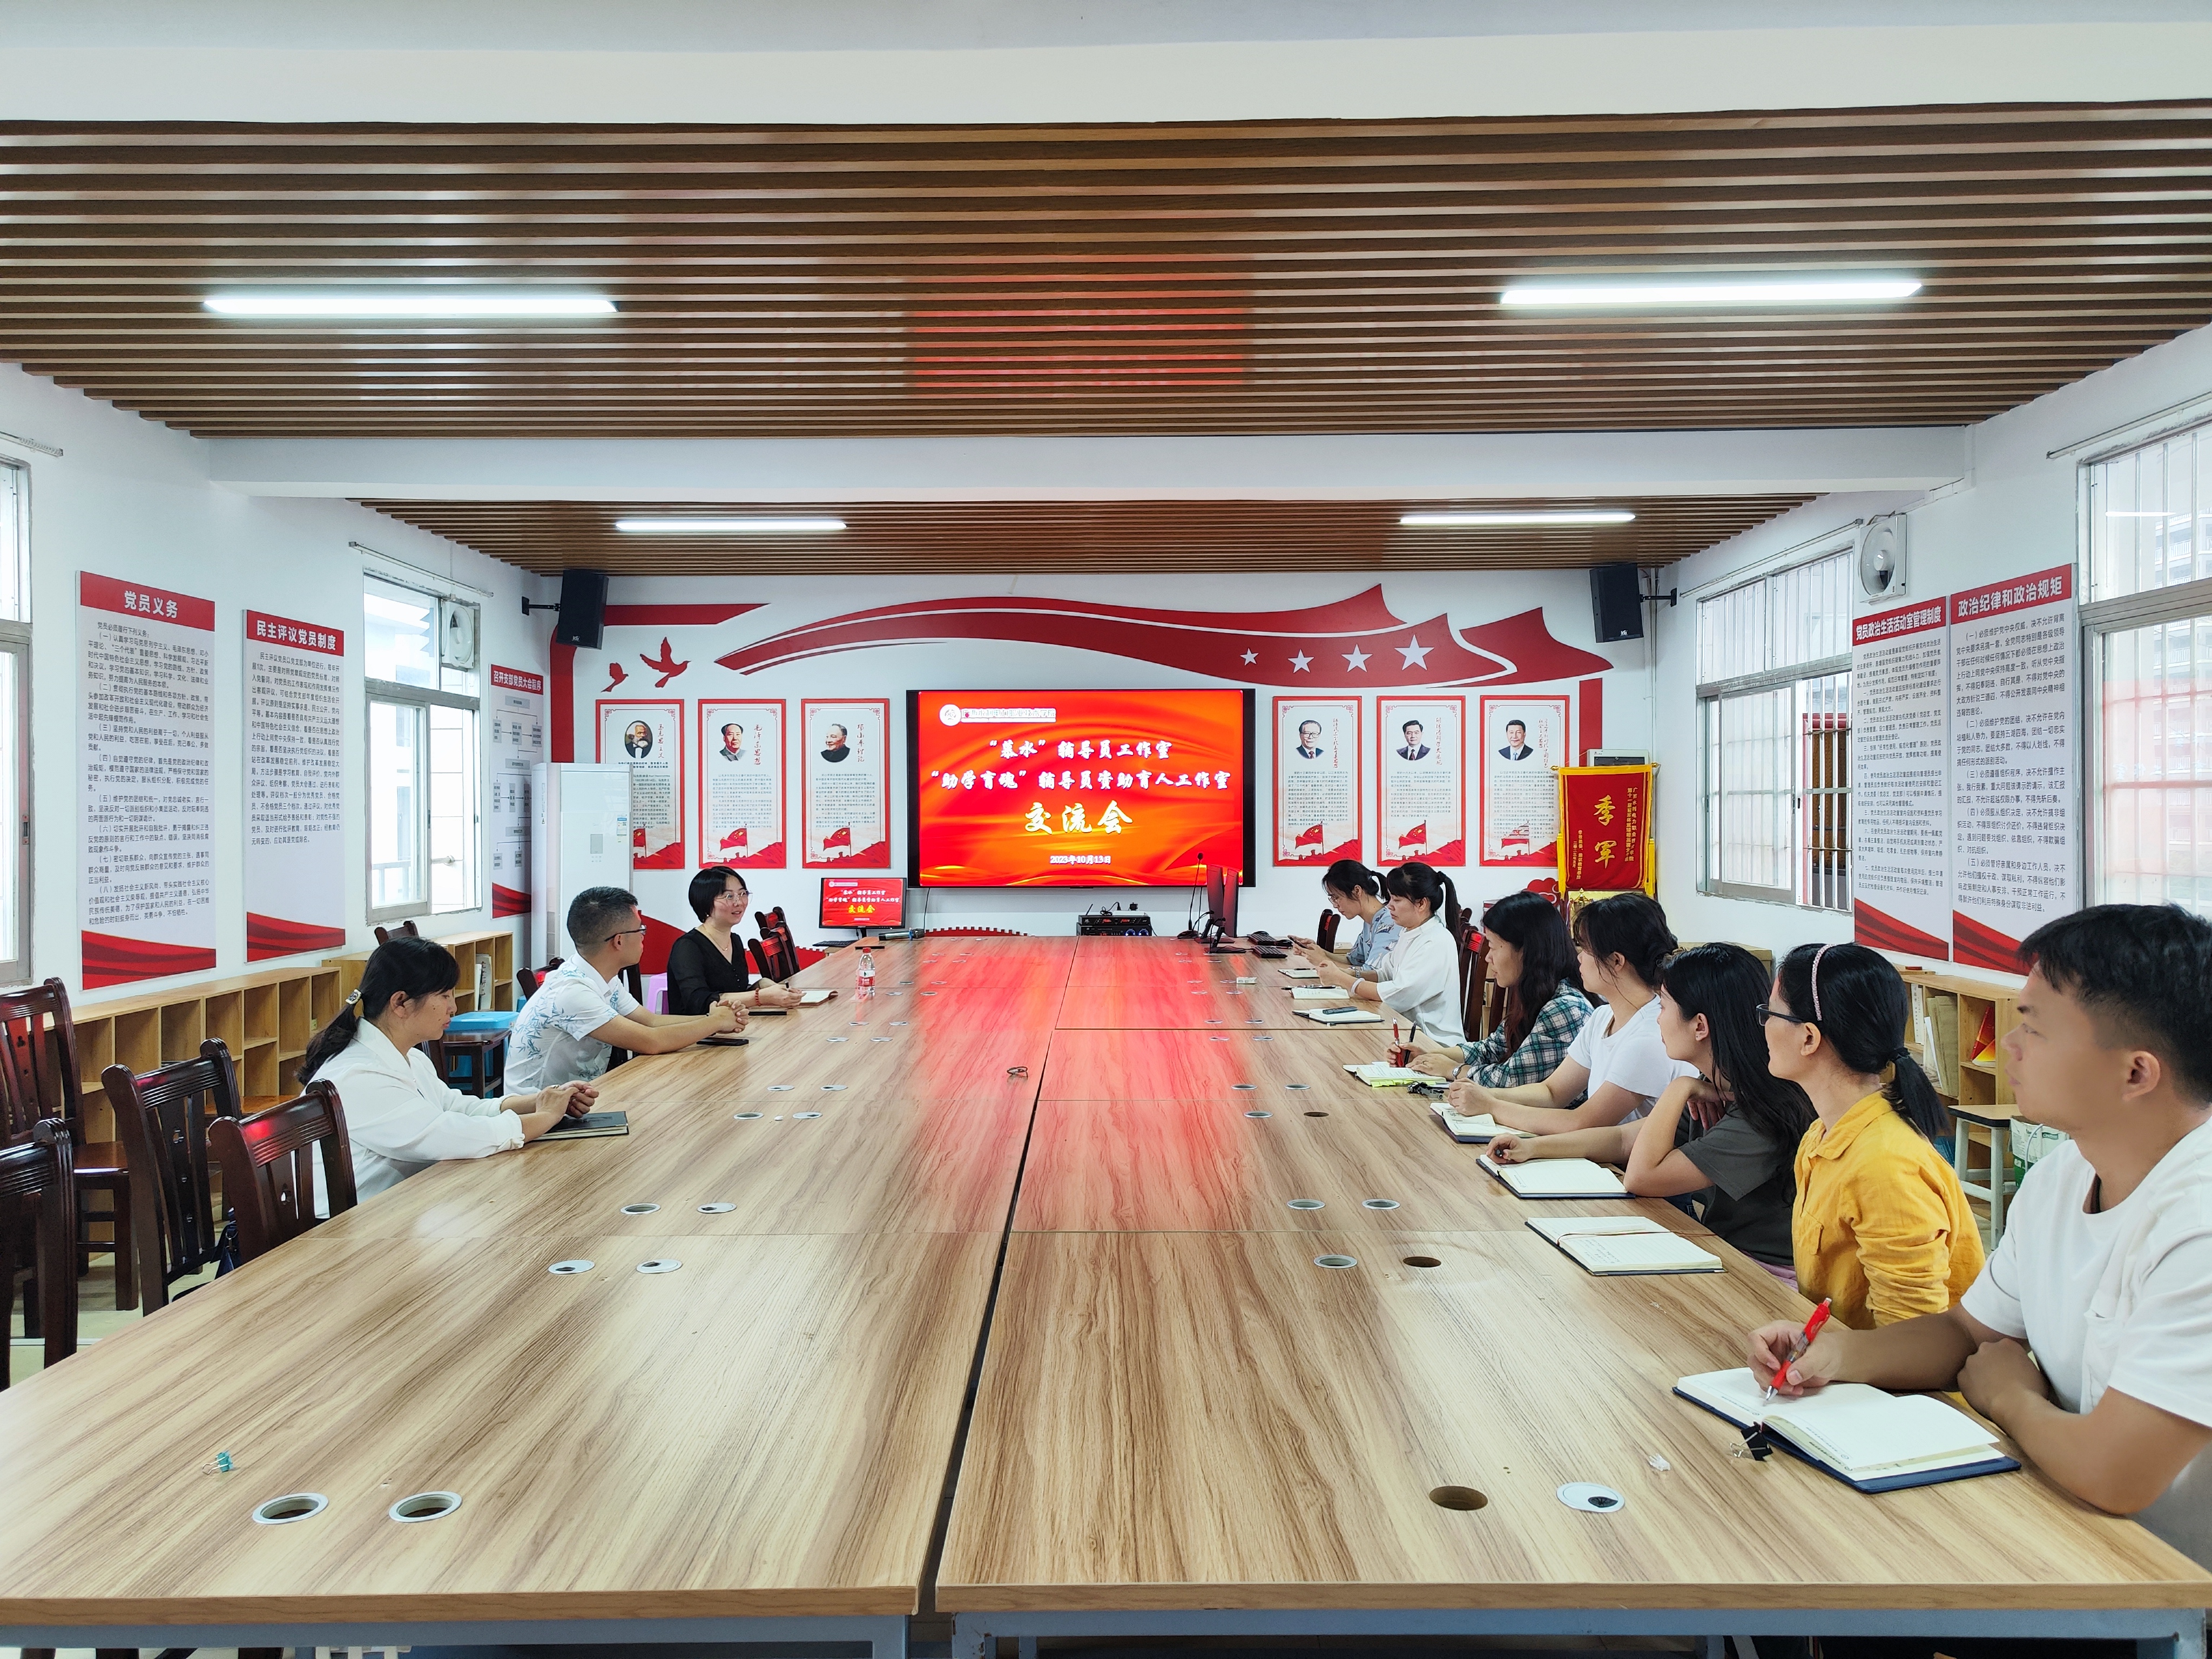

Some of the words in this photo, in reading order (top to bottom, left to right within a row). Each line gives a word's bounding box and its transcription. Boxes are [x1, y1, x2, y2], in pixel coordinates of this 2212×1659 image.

[124, 589, 178, 619] 党员义务
[1958, 575, 2062, 618] 政治纪律和政治规矩
[257, 619, 336, 651] 民主评议党员制度
[1856, 604, 1941, 641] 党员政治生活活动室管理制度
[494, 670, 541, 691] 召开支部党员大会程序
[1024, 800, 1133, 835] 交流会
[1050, 854, 1111, 865] 2023年10月13日
